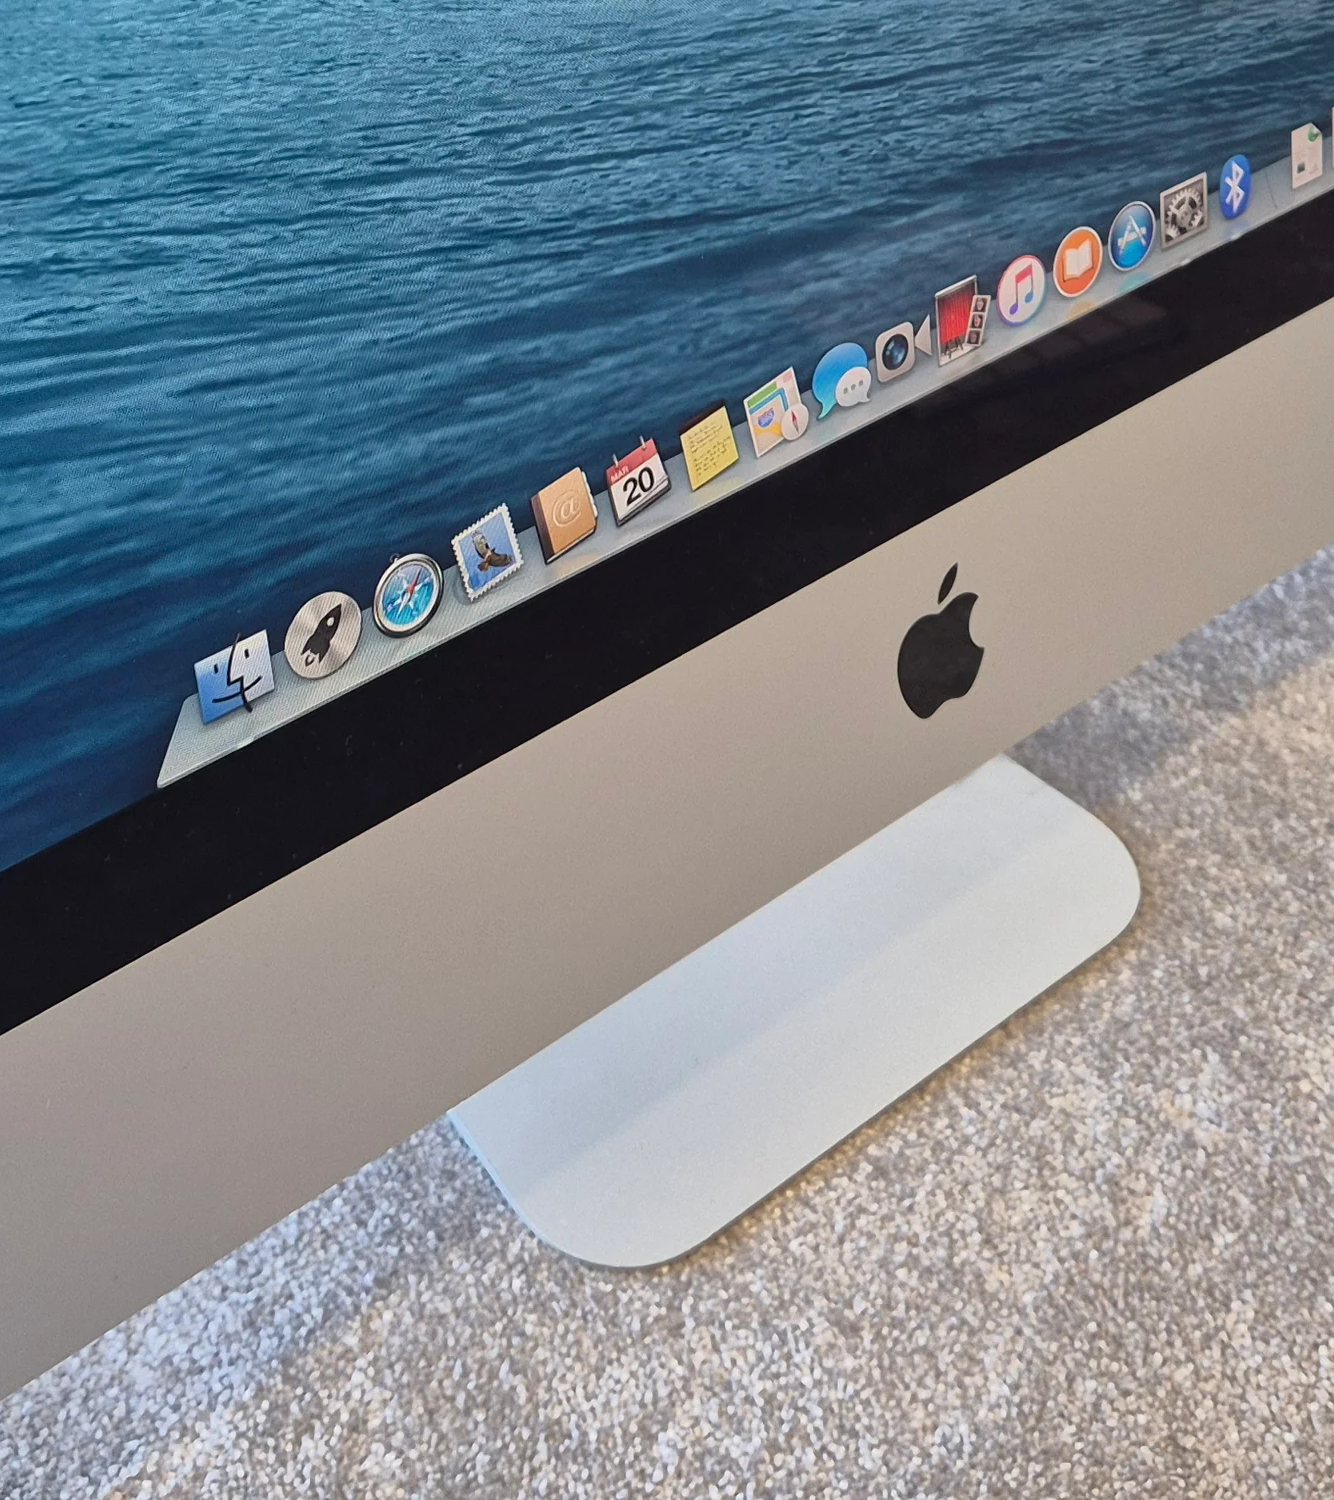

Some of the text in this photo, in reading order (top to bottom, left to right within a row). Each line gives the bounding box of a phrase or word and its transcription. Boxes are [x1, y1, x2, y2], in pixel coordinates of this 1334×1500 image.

[610, 465, 630, 484] MAR
[623, 466, 655, 507] 20
[551, 490, 582, 528] @
